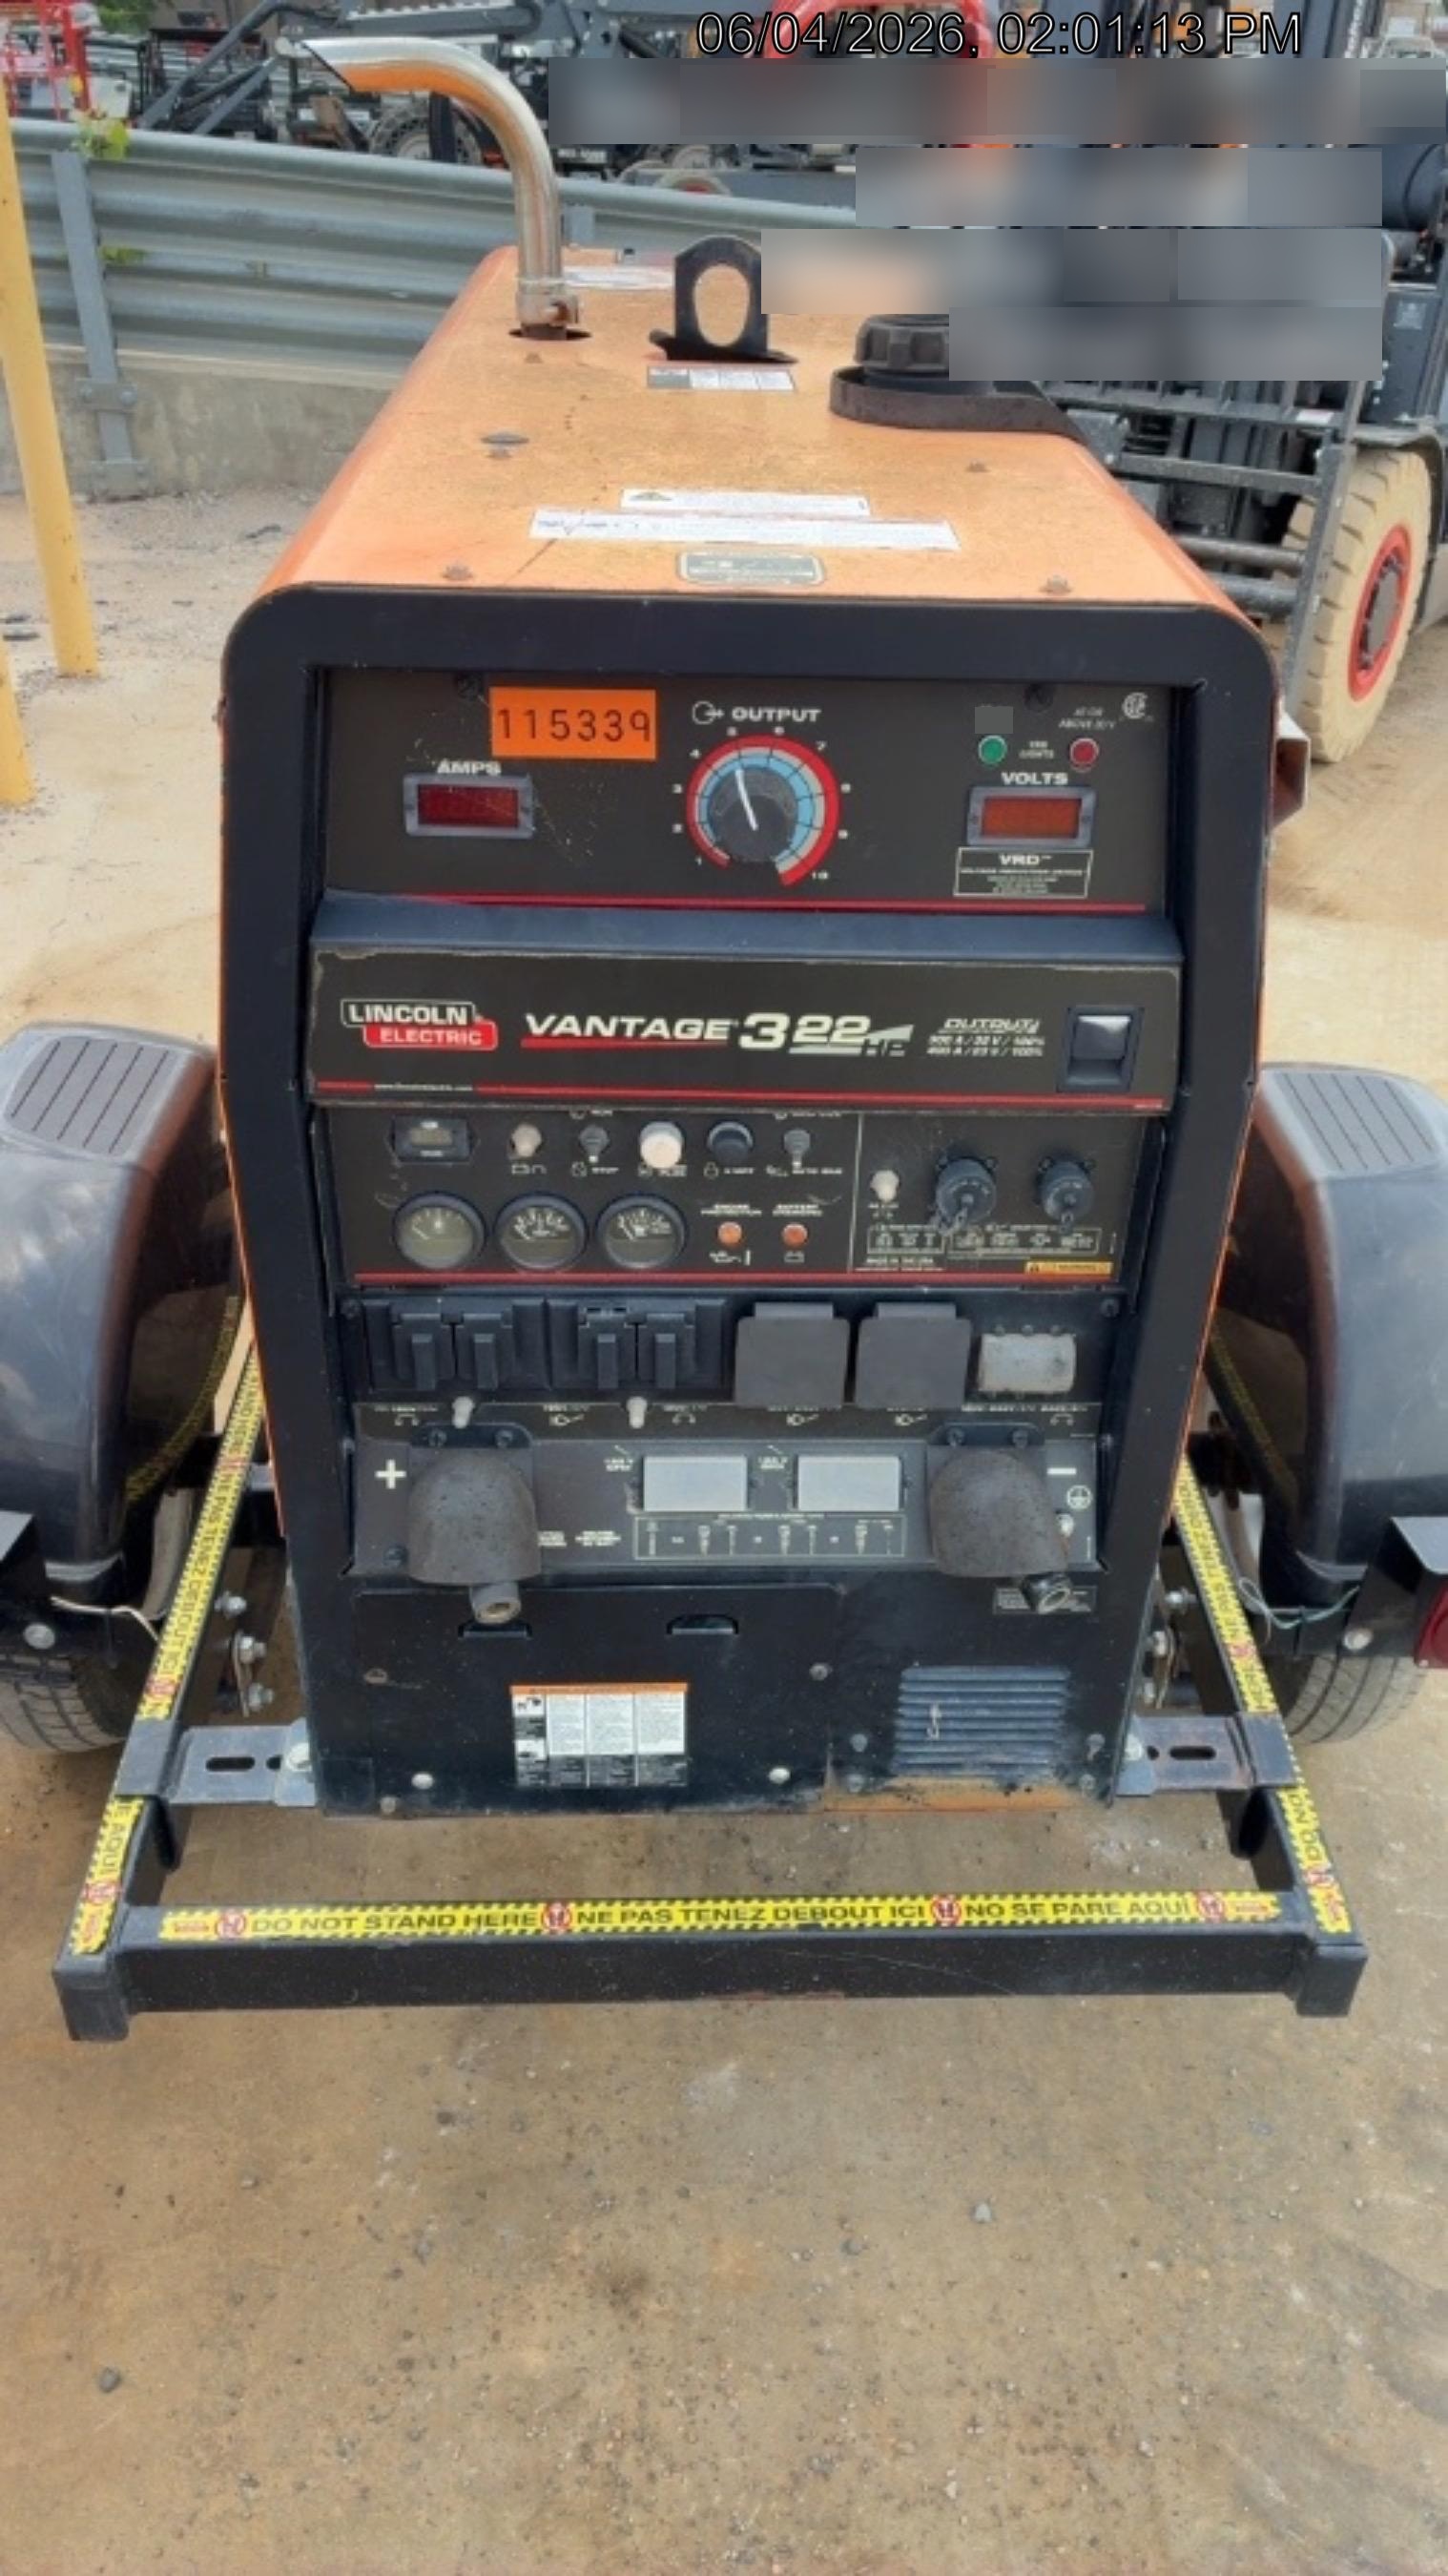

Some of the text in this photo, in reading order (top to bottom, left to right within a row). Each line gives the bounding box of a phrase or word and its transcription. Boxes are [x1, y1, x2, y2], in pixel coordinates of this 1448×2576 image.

[731, 706, 823, 723] OUTPUT
[496, 708, 653, 743] 115339
[437, 758, 503, 778] AMPS
[1001, 771, 1070, 787] VOLTS
[348, 1003, 468, 1026] LINCOLN
[379, 1028, 483, 1046] ELECTRIC
[524, 1012, 872, 1050] VANTAGE 322
[251, 1916, 294, 1933] DO
[300, 1916, 359, 1931] NOT
[363, 1913, 457, 1930] STAND
[462, 1911, 538, 1928] HERE
[576, 1910, 616, 1924] NE
[620, 1909, 673, 1923] PAS
[677, 1907, 765, 1922] TENEZ
[774, 1904, 882, 1921] DEBOUT
[890, 1904, 926, 1919] ICI
[965, 1904, 1006, 1920] NO
[1011, 1903, 1045, 1918] SE
[1052, 1901, 1123, 1917] PARE
